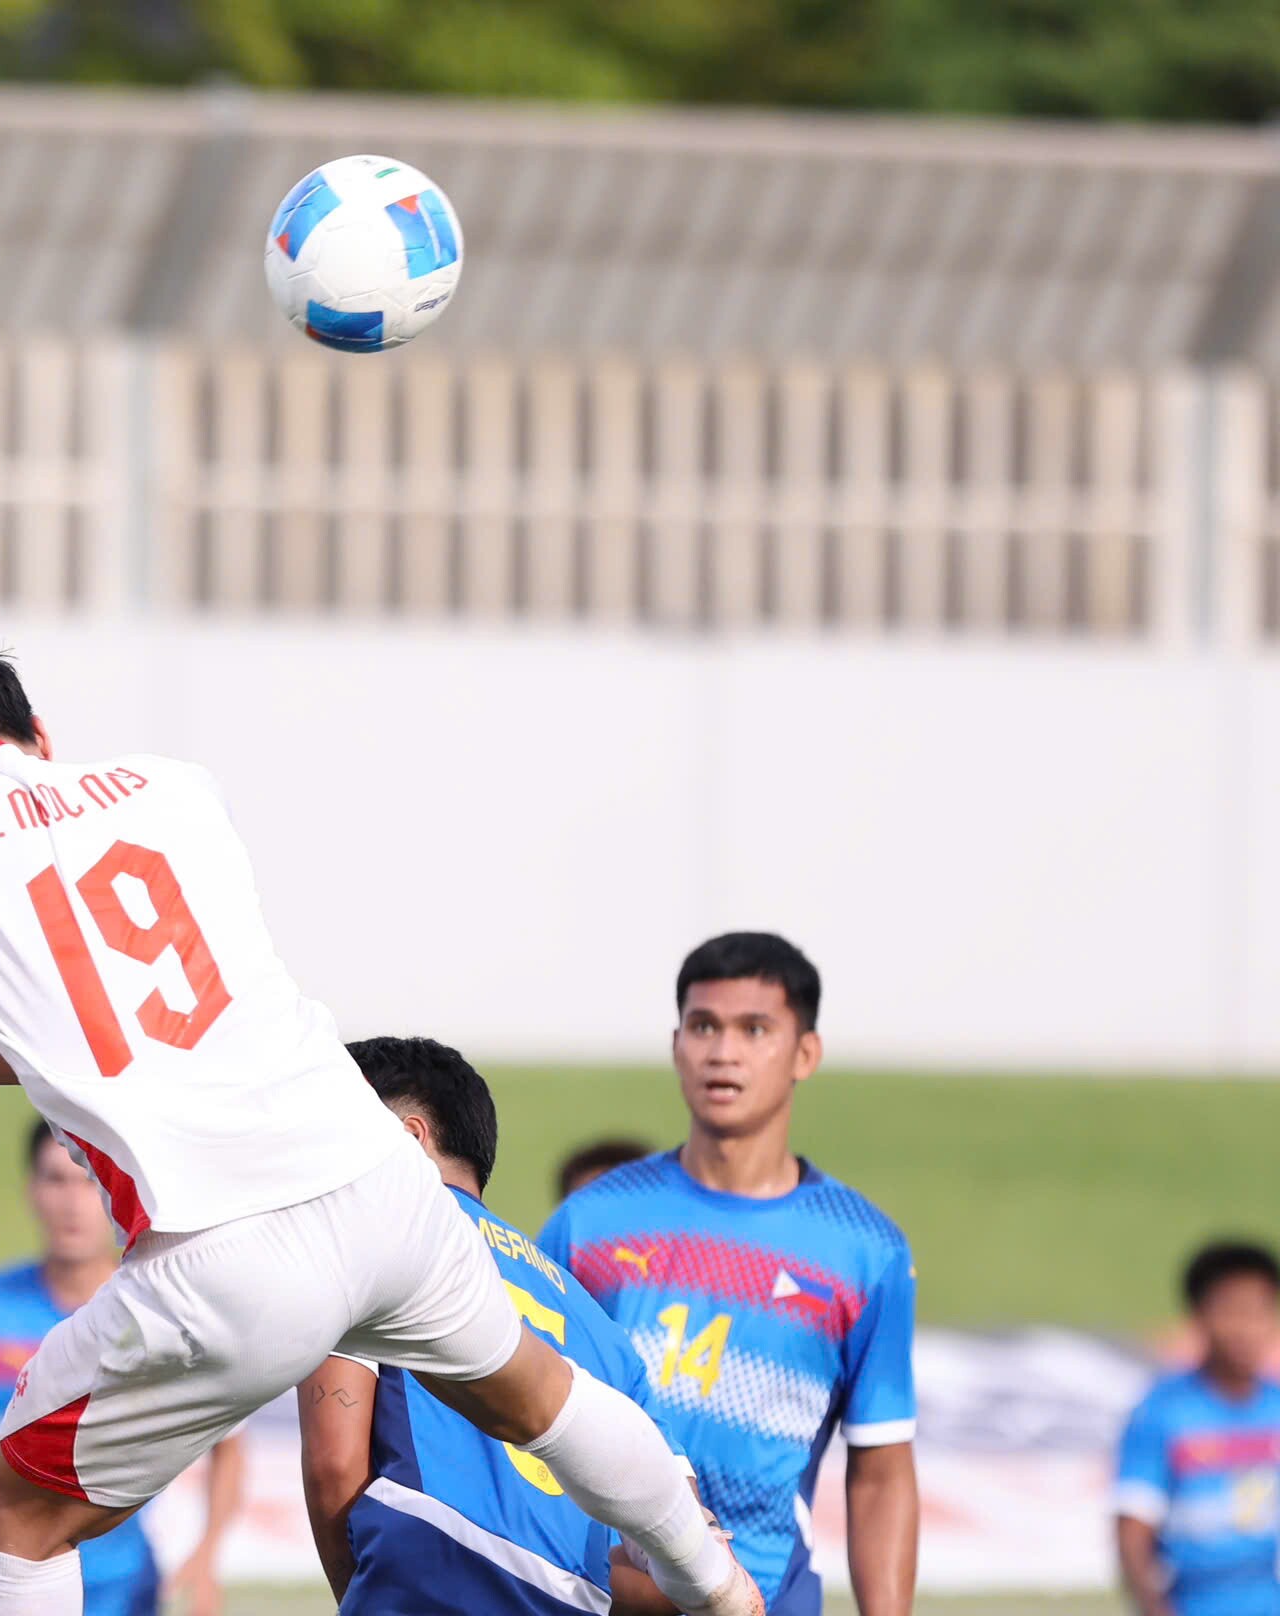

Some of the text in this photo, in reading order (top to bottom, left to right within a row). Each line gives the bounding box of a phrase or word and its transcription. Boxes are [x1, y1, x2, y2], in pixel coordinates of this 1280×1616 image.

[26, 839, 233, 1077] 19
[478, 1216, 567, 1295] MERINO
[657, 1303, 732, 1397] 14
